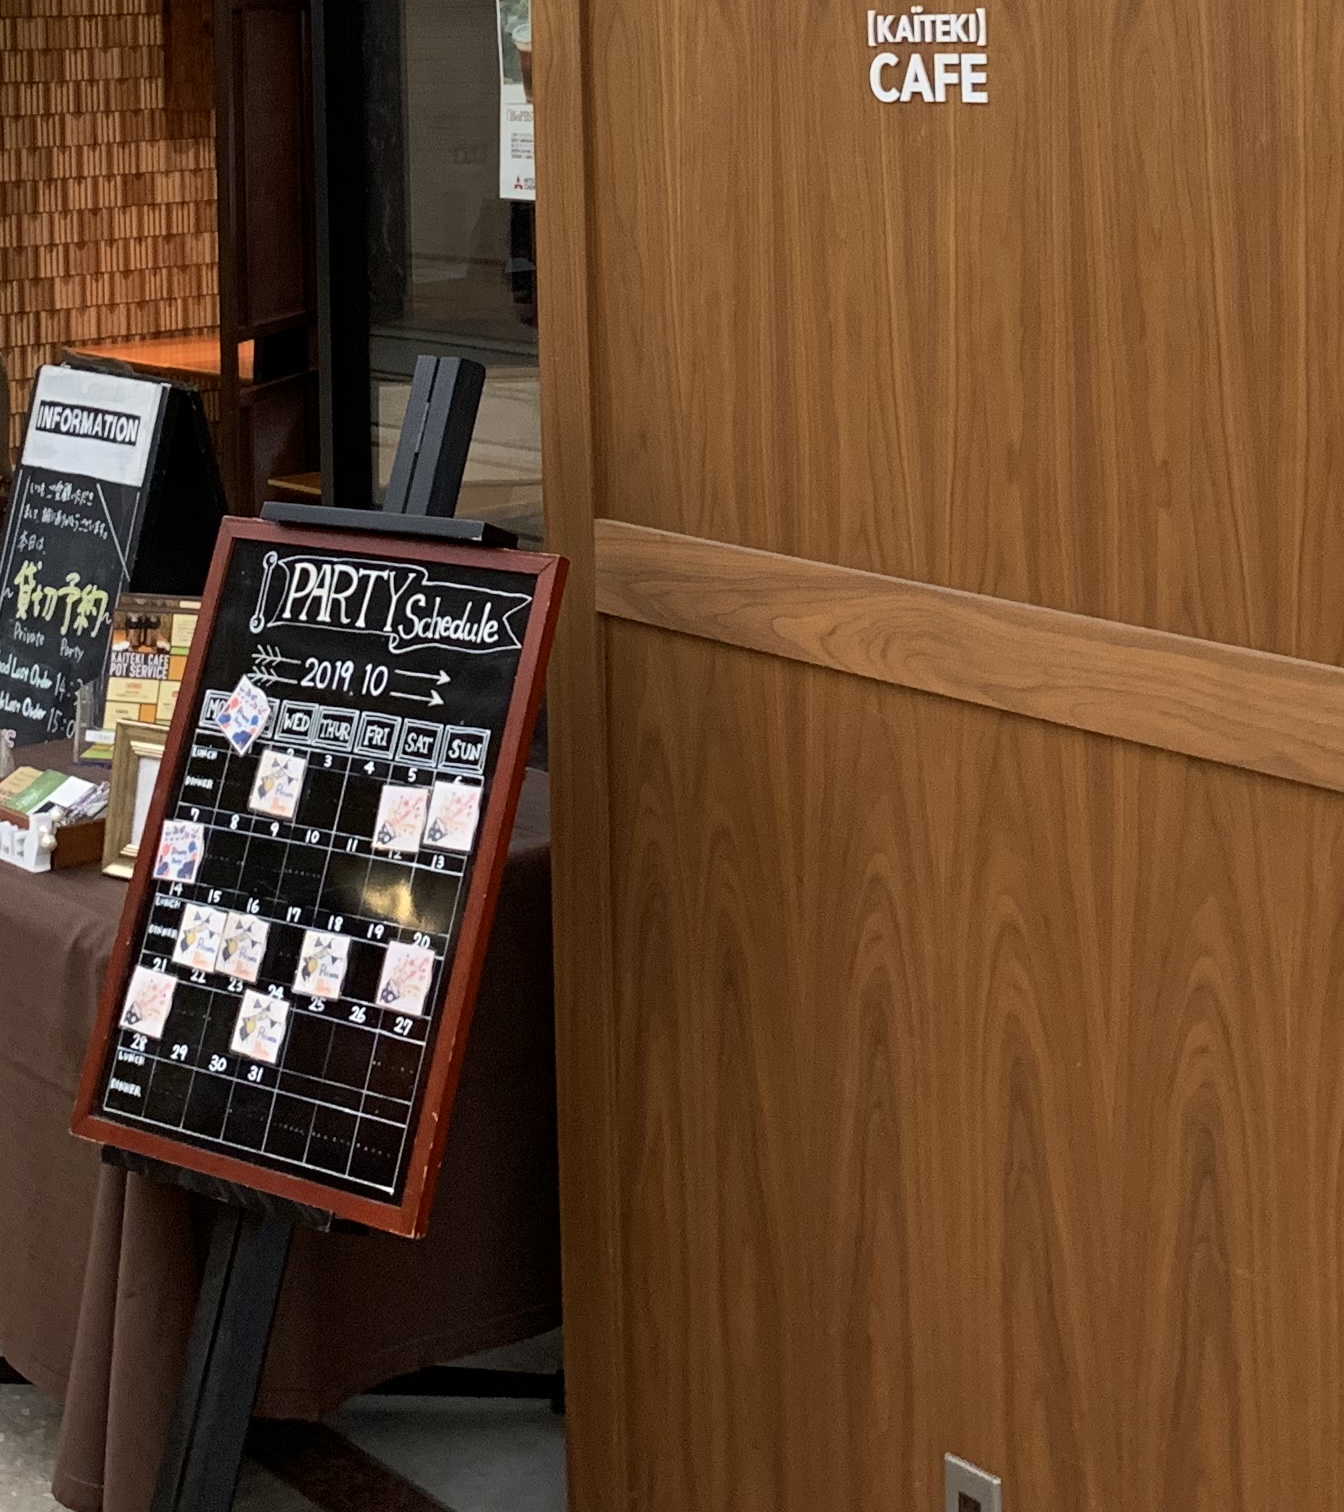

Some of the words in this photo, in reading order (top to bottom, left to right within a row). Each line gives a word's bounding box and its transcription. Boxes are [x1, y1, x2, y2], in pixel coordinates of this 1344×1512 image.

[869, 52, 989, 104] CAFE
[36, 404, 139, 443] INFORMATION
[282, 562, 416, 632] PARTY
[398, 593, 499, 643] Schedule
[14, 621, 45, 647] Private
[60, 638, 84, 663] Party
[111, 652, 145, 666] KAITEKI
[148, 654, 170, 667] CAFE
[10, 656, 30, 682] Last
[29, 664, 53, 689] Order
[109, 662, 128, 676] POT
[129, 664, 168, 679] SERVICE
[22, 696, 47, 721] Order
[283, 712, 310, 732] WED
[320, 719, 351, 741] THUR
[363, 725, 391, 747] FRI
[405, 732, 435, 754] SAT
[448, 738, 482, 761] SUN
[192, 746, 217, 760] LUNCH
[323, 755, 333, 768] 3
[363, 761, 375, 775] 4
[408, 768, 418, 782] 5
[184, 775, 213, 789] DINNER
[190, 808, 200, 821] 7
[230, 814, 239, 830] 8
[270, 822, 280, 837] 9
[305, 829, 320, 844] 10
[346, 838, 359, 852] 11
[432, 855, 445, 869] 13
[156, 897, 181, 909] LUNCH
[169, 882, 184, 896] 14
[207, 889, 222, 904] 15
[246, 897, 260, 914] 16
[286, 906, 302, 923] 17
[327, 915, 343, 931] 18
[366, 924, 385, 939] 19
[148, 923, 179, 939] DINNER
[152, 958, 168, 972] 21
[190, 968, 207, 983] 22
[227, 977, 244, 992] 23
[268, 984, 284, 999] 24
[308, 997, 326, 1012] 25
[348, 1006, 366, 1023] 26
[393, 1016, 413, 1035] 27
[118, 1051, 146, 1066] LUNCH
[130, 1033, 148, 1051] 28
[170, 1044, 188, 1062] 29
[208, 1054, 227, 1072] 30
[247, 1065, 264, 1083] 31
[110, 1077, 141, 1098] DINNER
